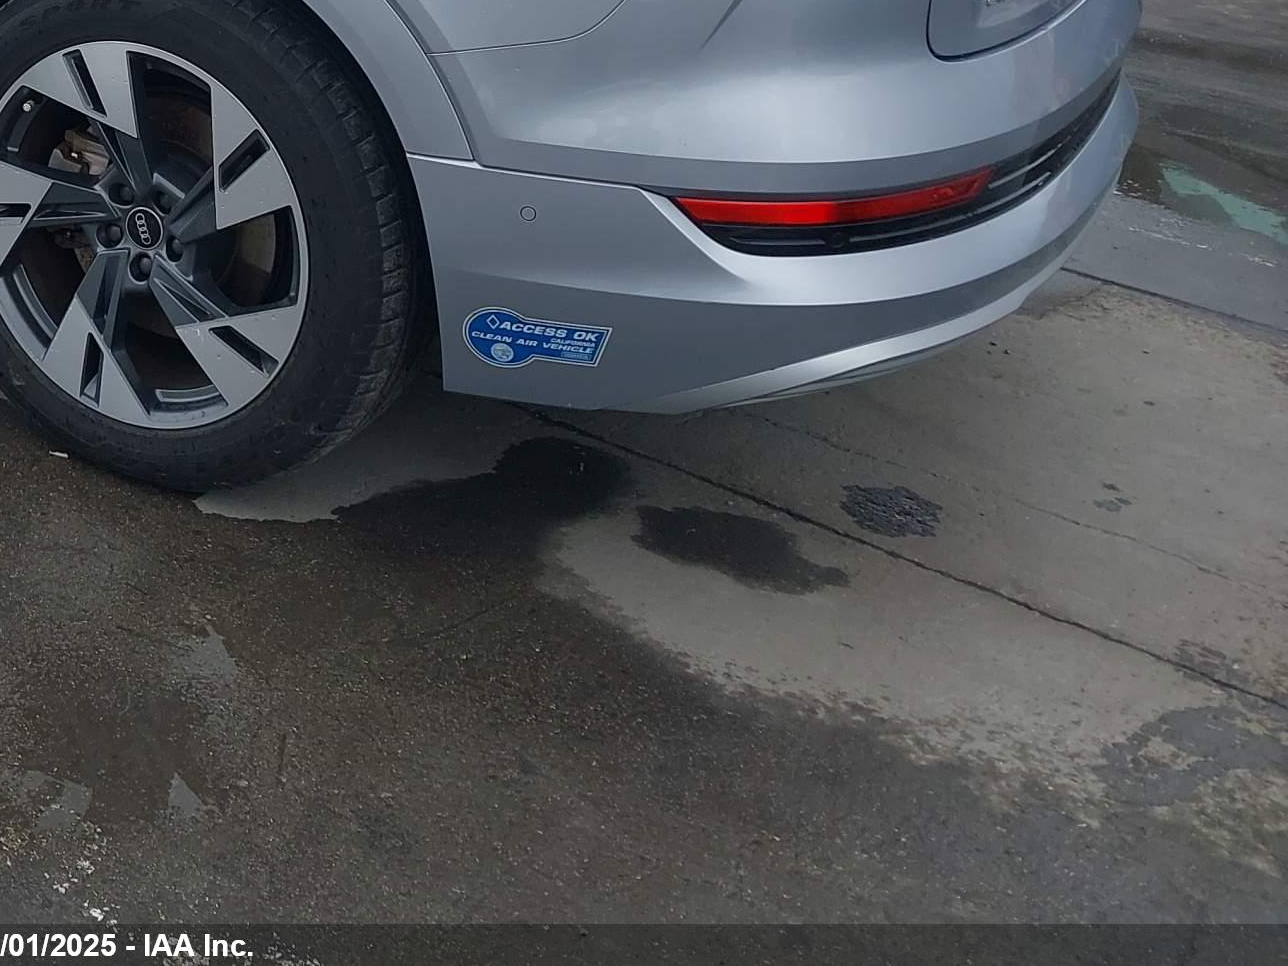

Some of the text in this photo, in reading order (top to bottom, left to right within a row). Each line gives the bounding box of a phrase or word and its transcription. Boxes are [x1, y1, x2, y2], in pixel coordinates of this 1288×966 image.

[498, 321, 601, 342] ACCESS OK
[471, 331, 595, 354] CLEAN AIR VEHICLE
[550, 337, 596, 348] CALIFORNIA
